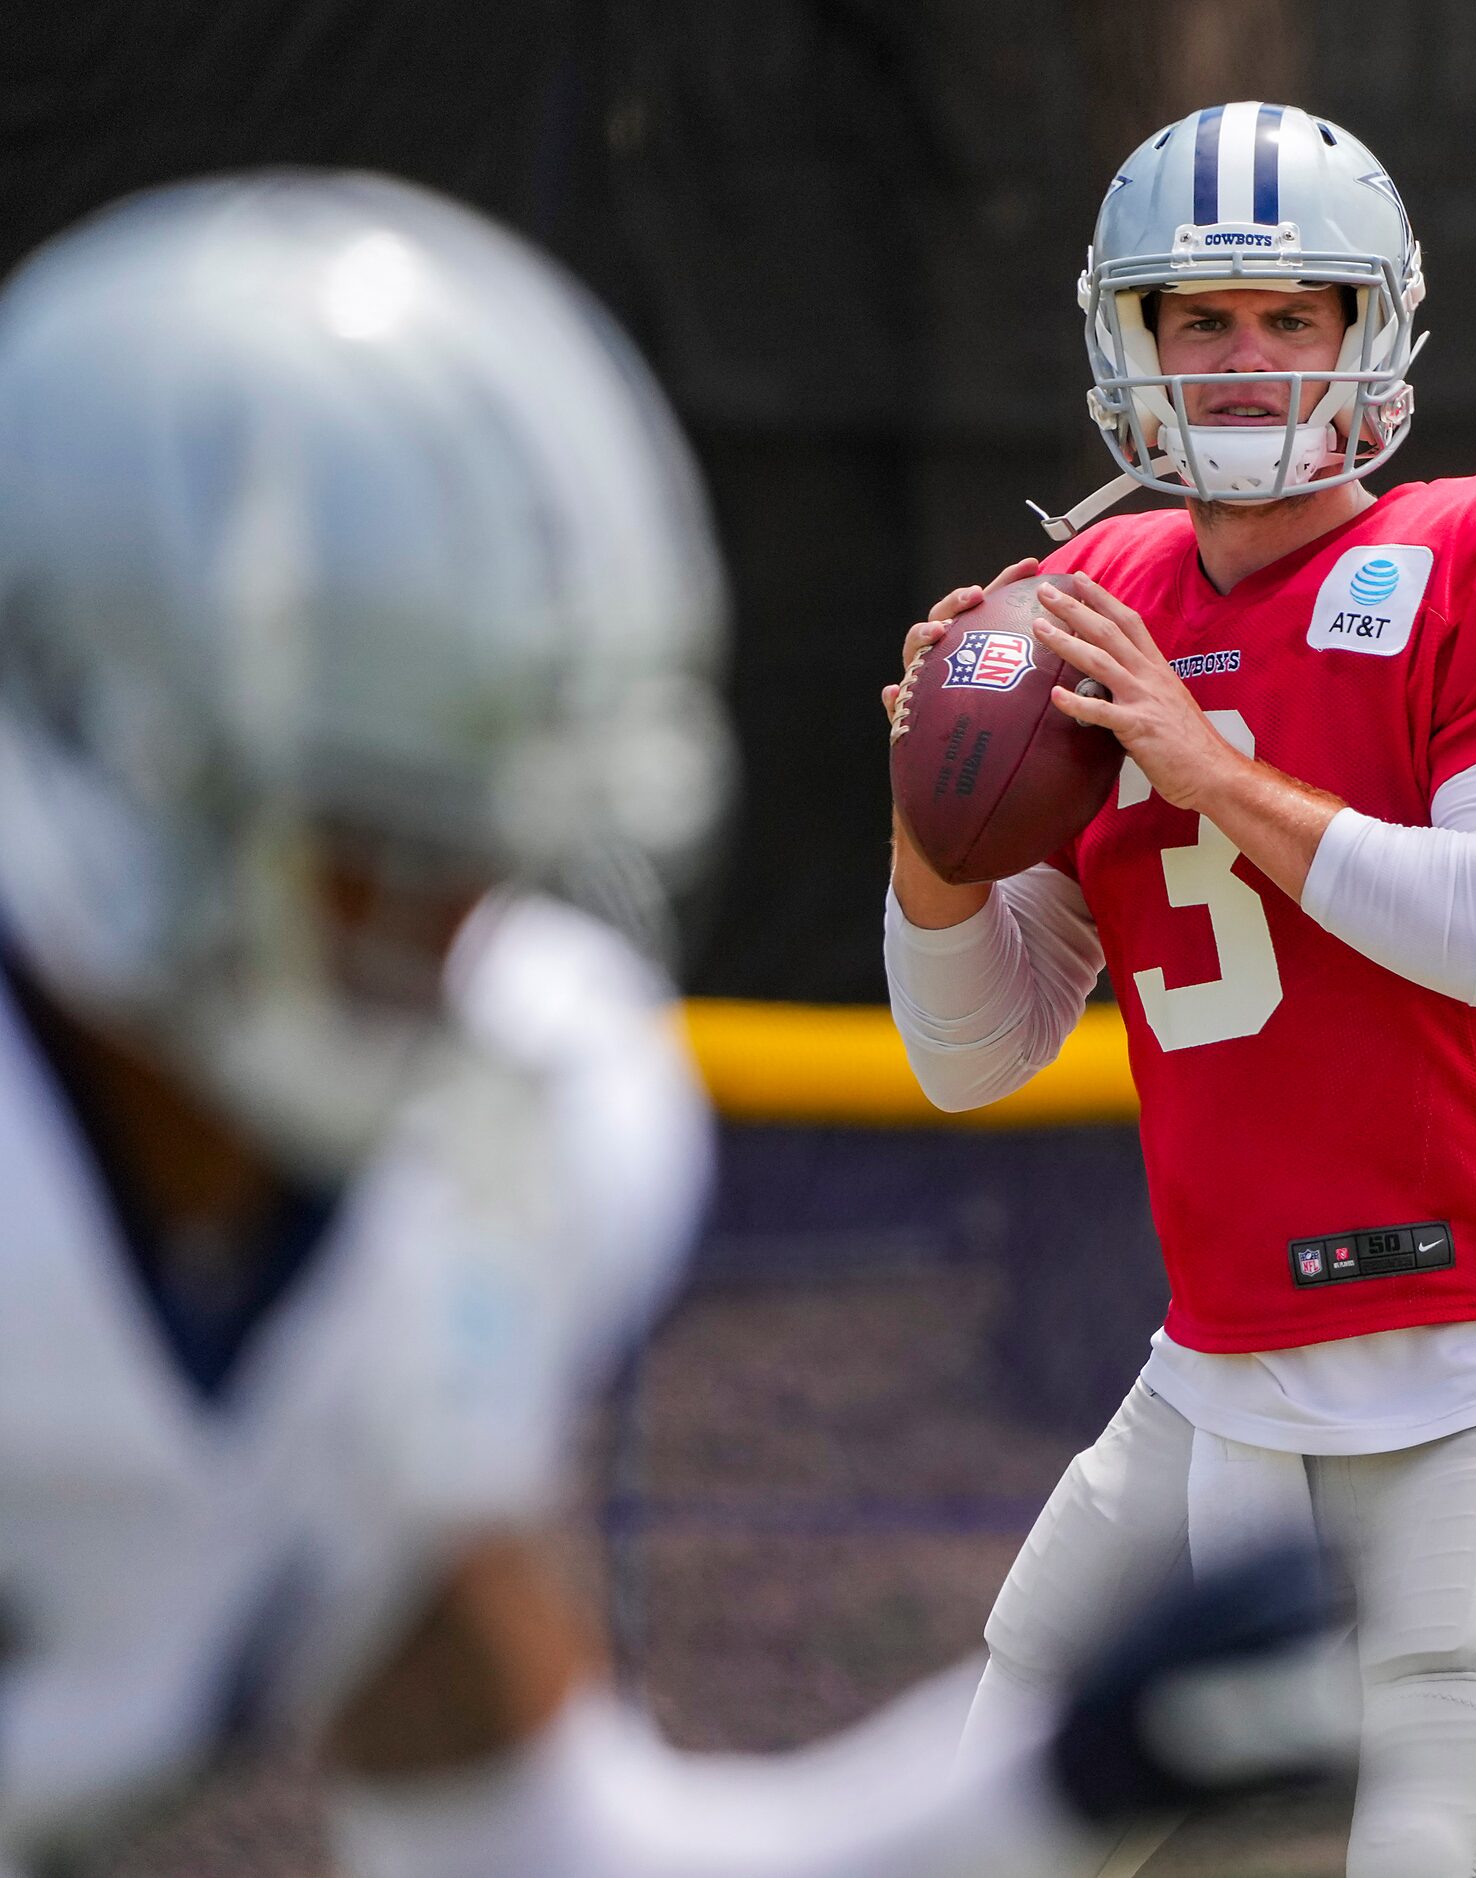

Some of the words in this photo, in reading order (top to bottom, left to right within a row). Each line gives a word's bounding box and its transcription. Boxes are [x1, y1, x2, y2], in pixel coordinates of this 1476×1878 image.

[1204, 233, 1272, 247] COWBOYS
[1328, 612, 1391, 639] AT&T
[976, 639, 1025, 684] NFL
[1117, 709, 1284, 1053] 3
[1368, 1233, 1400, 1255] 50
[1302, 1260, 1320, 1273] NFL
